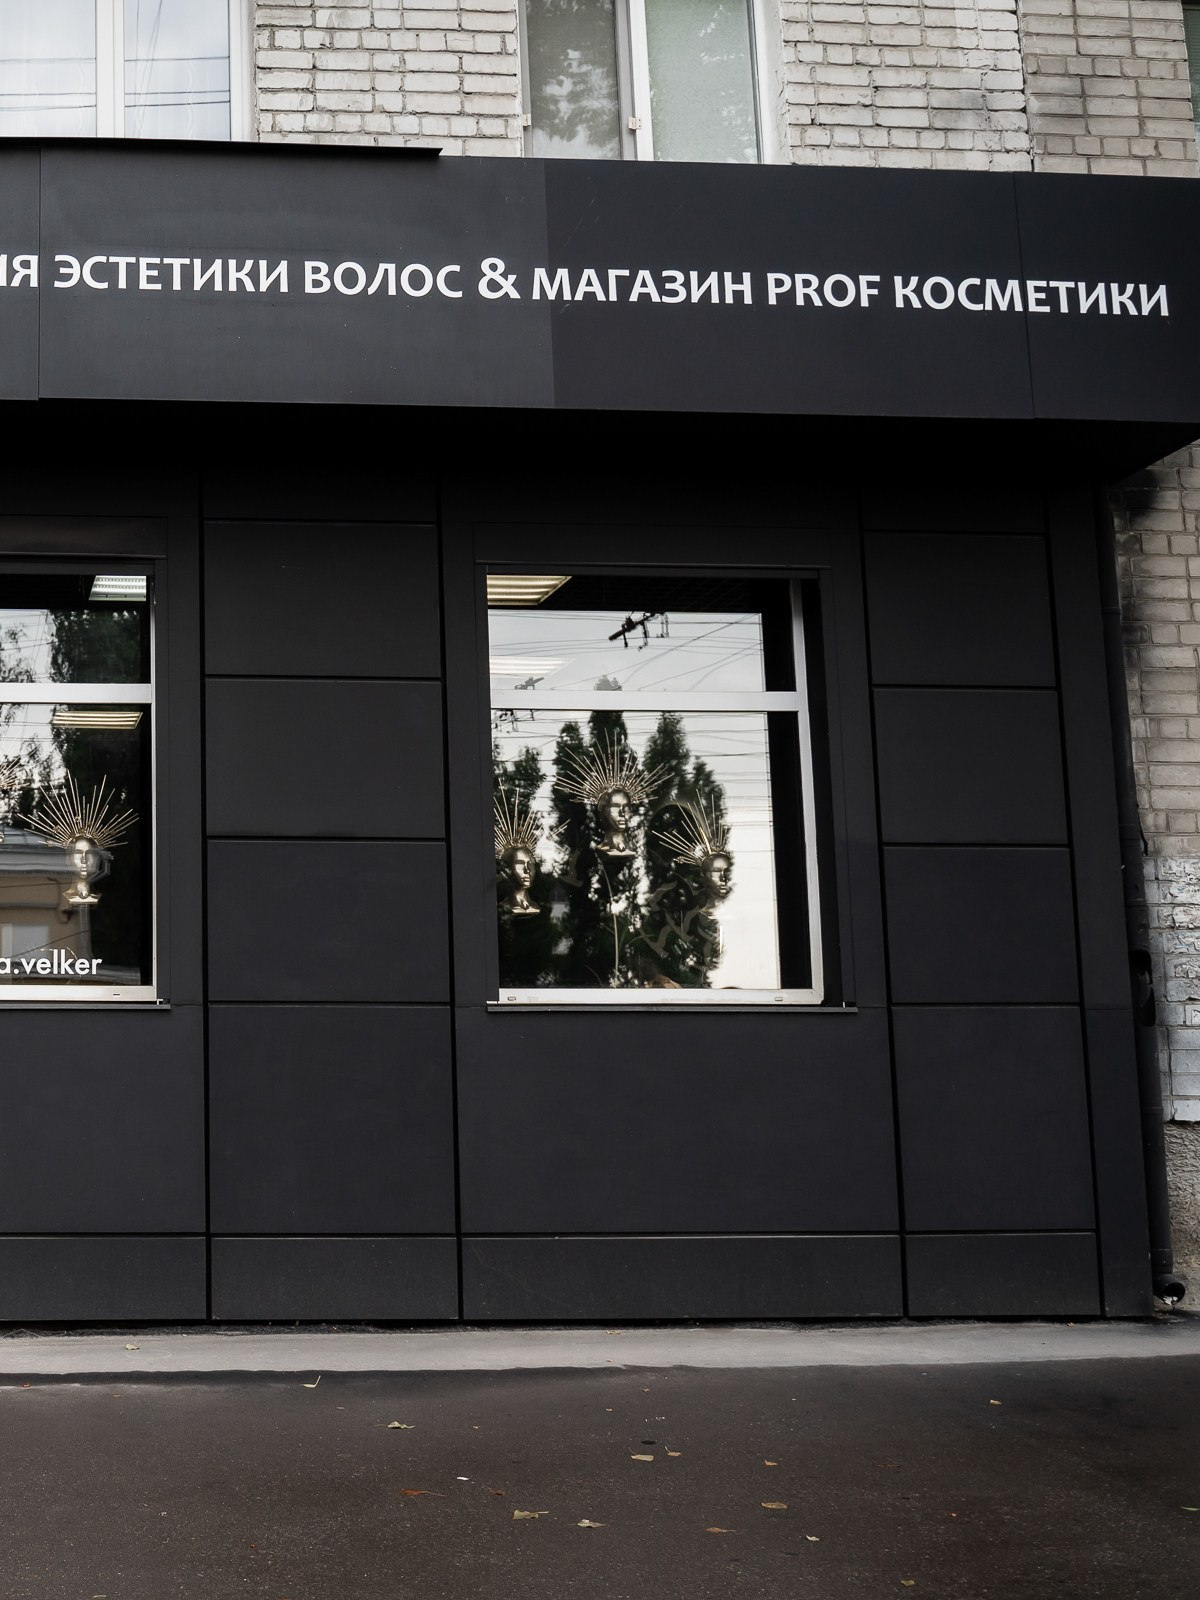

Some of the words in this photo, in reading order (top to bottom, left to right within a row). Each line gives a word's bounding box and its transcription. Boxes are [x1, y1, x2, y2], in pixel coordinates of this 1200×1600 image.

[53, 254, 289, 293] ЭСТЕТИКИ
[304, 260, 463, 298] ВОЛОС
[477, 257, 522, 299] &
[531, 267, 753, 305] МАГАЗИН
[766, 273, 881, 307] PROF
[893, 275, 1169, 317] КОСМЕТИКИ
